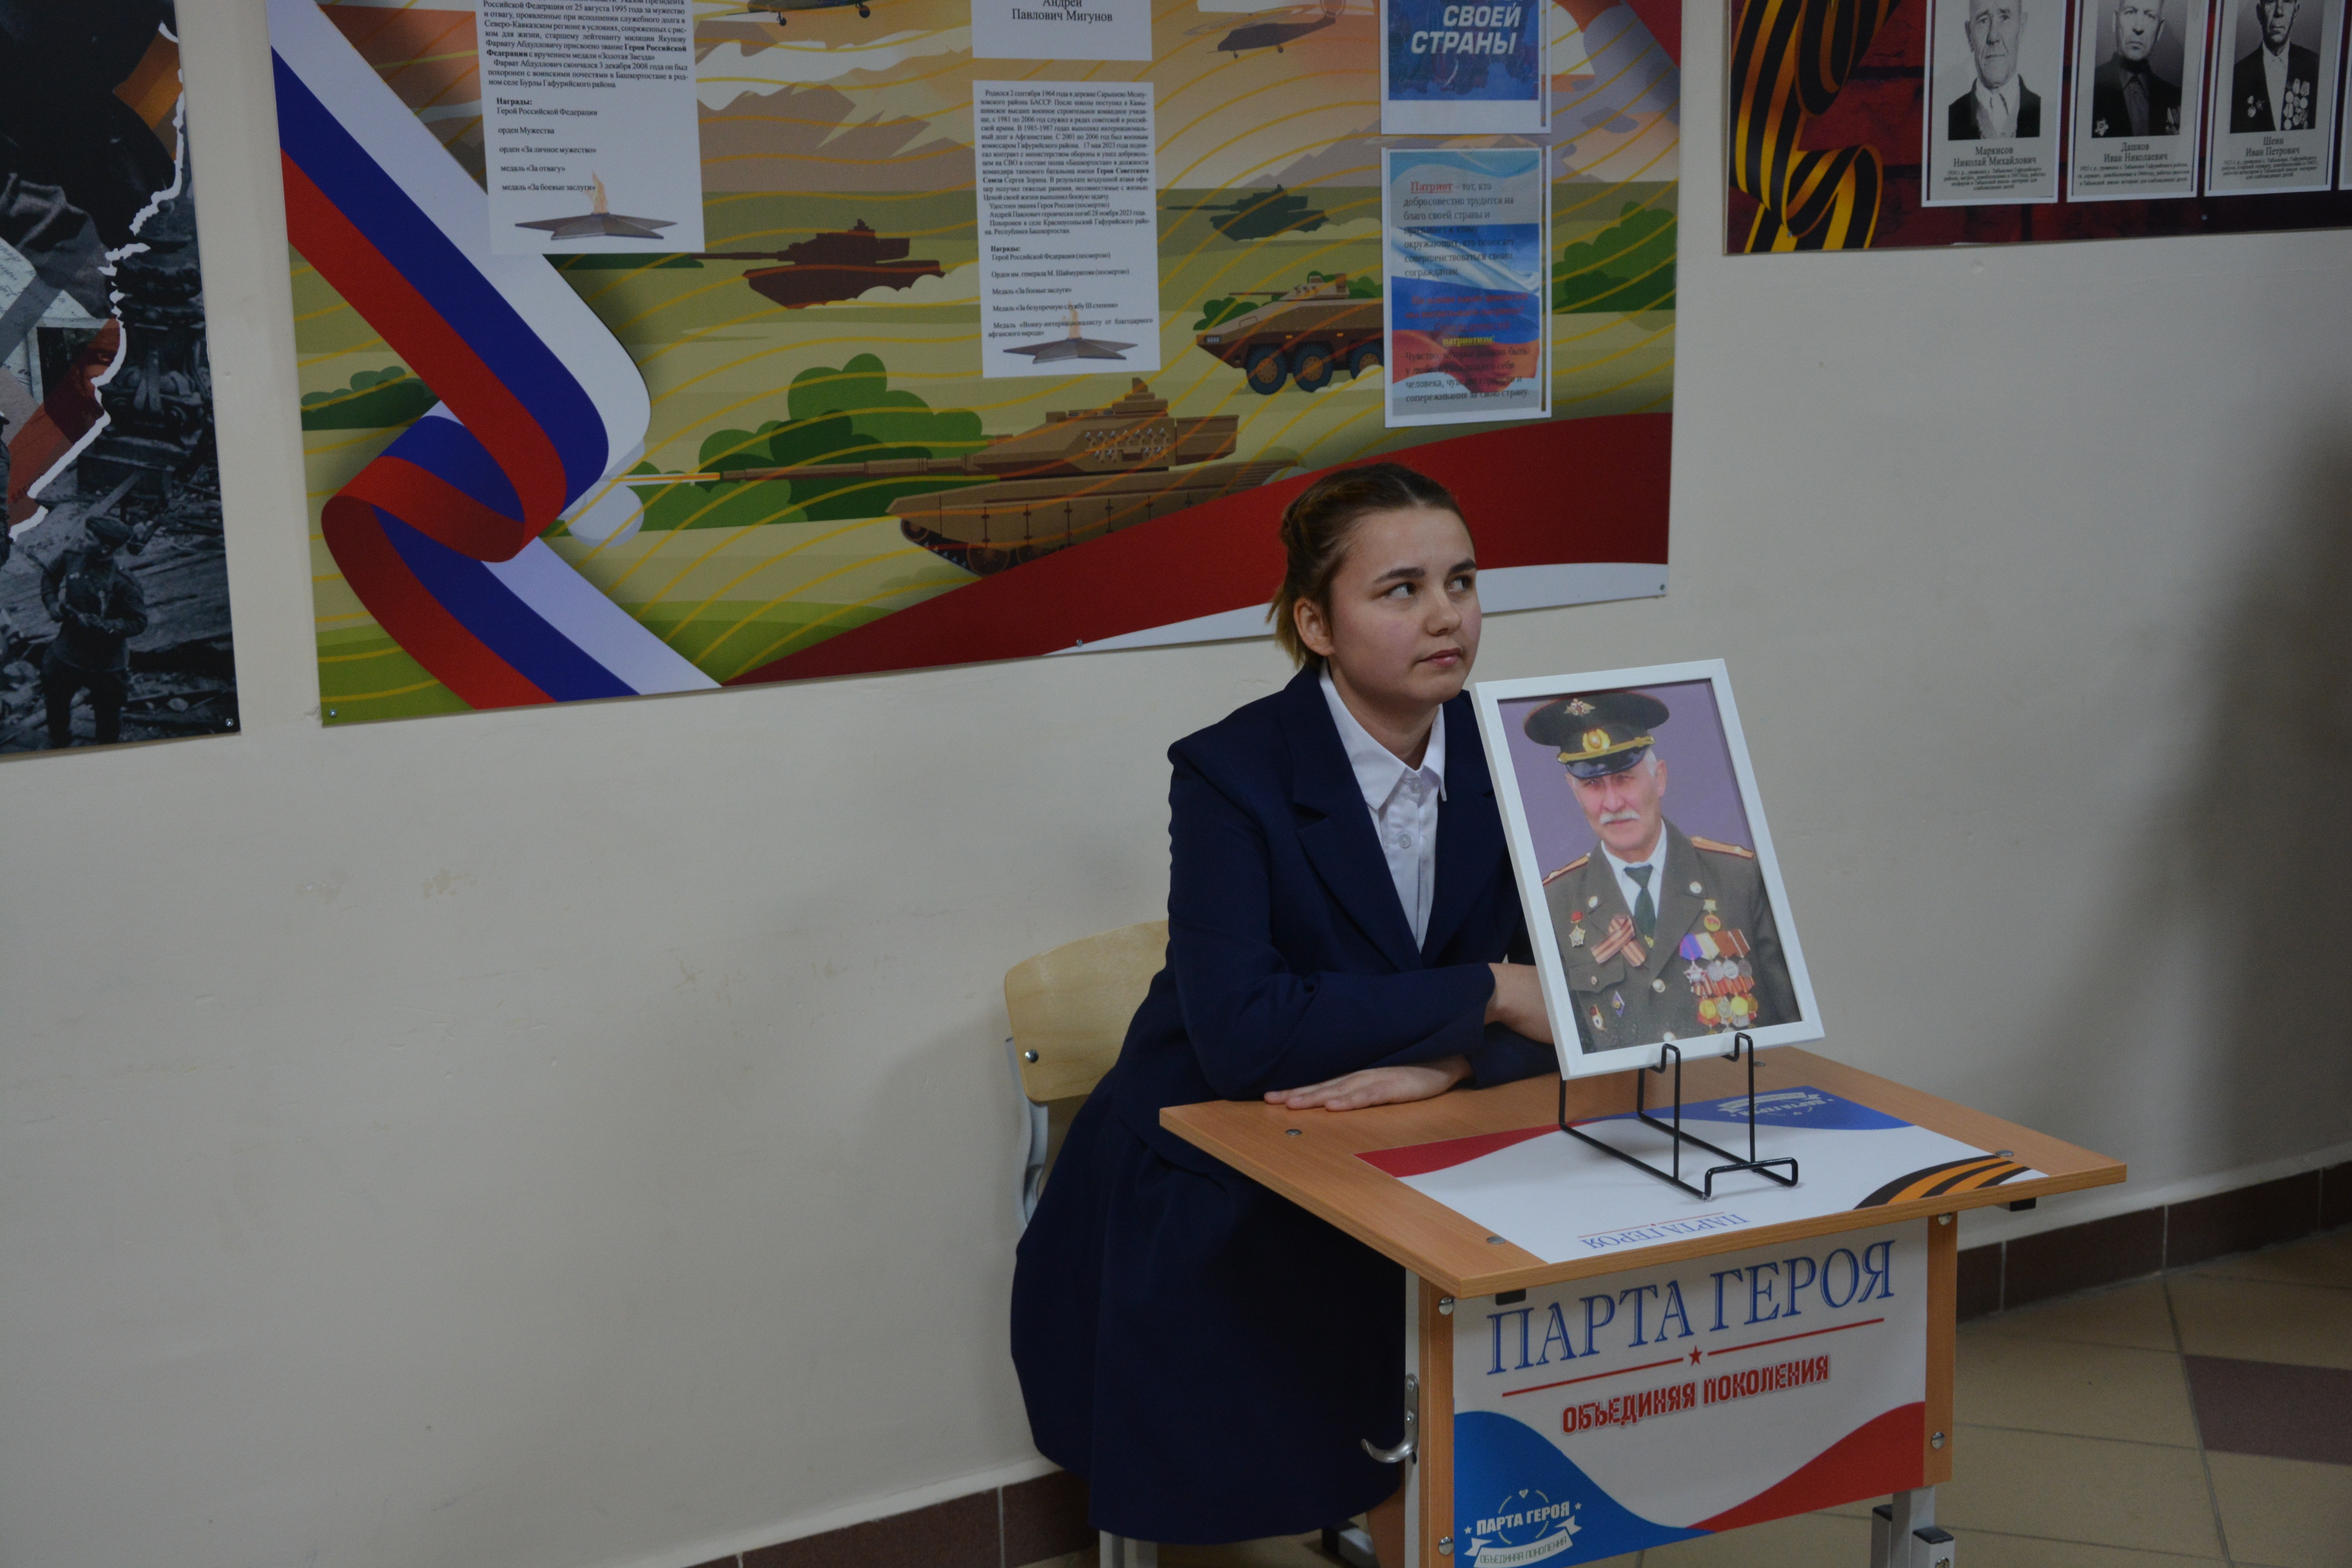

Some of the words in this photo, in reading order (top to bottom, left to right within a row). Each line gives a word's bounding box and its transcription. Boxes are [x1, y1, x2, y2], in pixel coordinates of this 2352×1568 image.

[483, 0, 524, 9] Российской
[525, 2, 564, 11] Федерации
[620, 15, 660, 24] служебного
[1012, 9, 1063, 20] Павлович
[1067, 10, 1112, 24] Мигунов
[1443, 2, 1522, 27] СВОЕЙ
[484, 20, 552, 29] Северо-Кавказском
[545, 33, 578, 41] старшему
[583, 33, 621, 42] лейтенанту
[659, 35, 686, 44] Якупову
[1411, 31, 1517, 54] СТРАНЫ
[486, 39, 514, 49] Фарвату
[517, 40, 561, 50] Абдулловичу
[625, 44, 644, 52] Героя
[486, 49, 528, 58] Федерации
[493, 59, 519, 68] Фарват
[521, 60, 562, 69] Абдуллович
[604, 62, 631, 71] декабря
[616, 71, 666, 81] Башкортостане
[520, 79, 542, 88] Бурлы
[543, 79, 591, 88] Гафурийского
[496, 98, 532, 106] Награды:
[497, 107, 517, 116] Герой
[559, 108, 598, 117] Федерации
[520, 127, 555, 135] Мужества
[1975, 146, 2013, 156] Маркисов
[2121, 142, 2149, 152] Дашков
[2245, 148, 2264, 157] Иван
[2266, 147, 2300, 156] Петрович
[1953, 158, 1986, 167] Николай
[1989, 156, 2036, 165] Михайлович
[2104, 154, 2122, 162] Иван
[2125, 153, 2168, 162] Николаевич
[1411, 181, 1452, 193] Патриот
[1403, 197, 1465, 208] добросовестно
[1467, 197, 1502, 207] трудится
[1404, 211, 1426, 220] благо
[1429, 211, 1452, 219] своей
[1455, 211, 1482, 221] страны
[1406, 379, 1444, 389] человека,
[1406, 392, 1468, 403] сопереживания
[1661, 1214, 1750, 1234] ПАРТА
[1579, 1228, 1668, 1249] ГЕРОЯ
[1486, 1279, 1695, 1375] ПАРТА
[1710, 1240, 1896, 1332] ГЕРОЯ
[1563, 1381, 1696, 1434] ОБЪЕДИНЯЯ
[1703, 1355, 1829, 1405] ПОКОЛЕНИЯ
[1477, 1513, 1523, 1535] ПАРТА
[1527, 1501, 1570, 1523] ГЕРОЯ
[1480, 1551, 1524, 1564] ОБЪЕДИНЯЯ
[1525, 1536, 1567, 1559] ПОКОЛЕНИЯ
